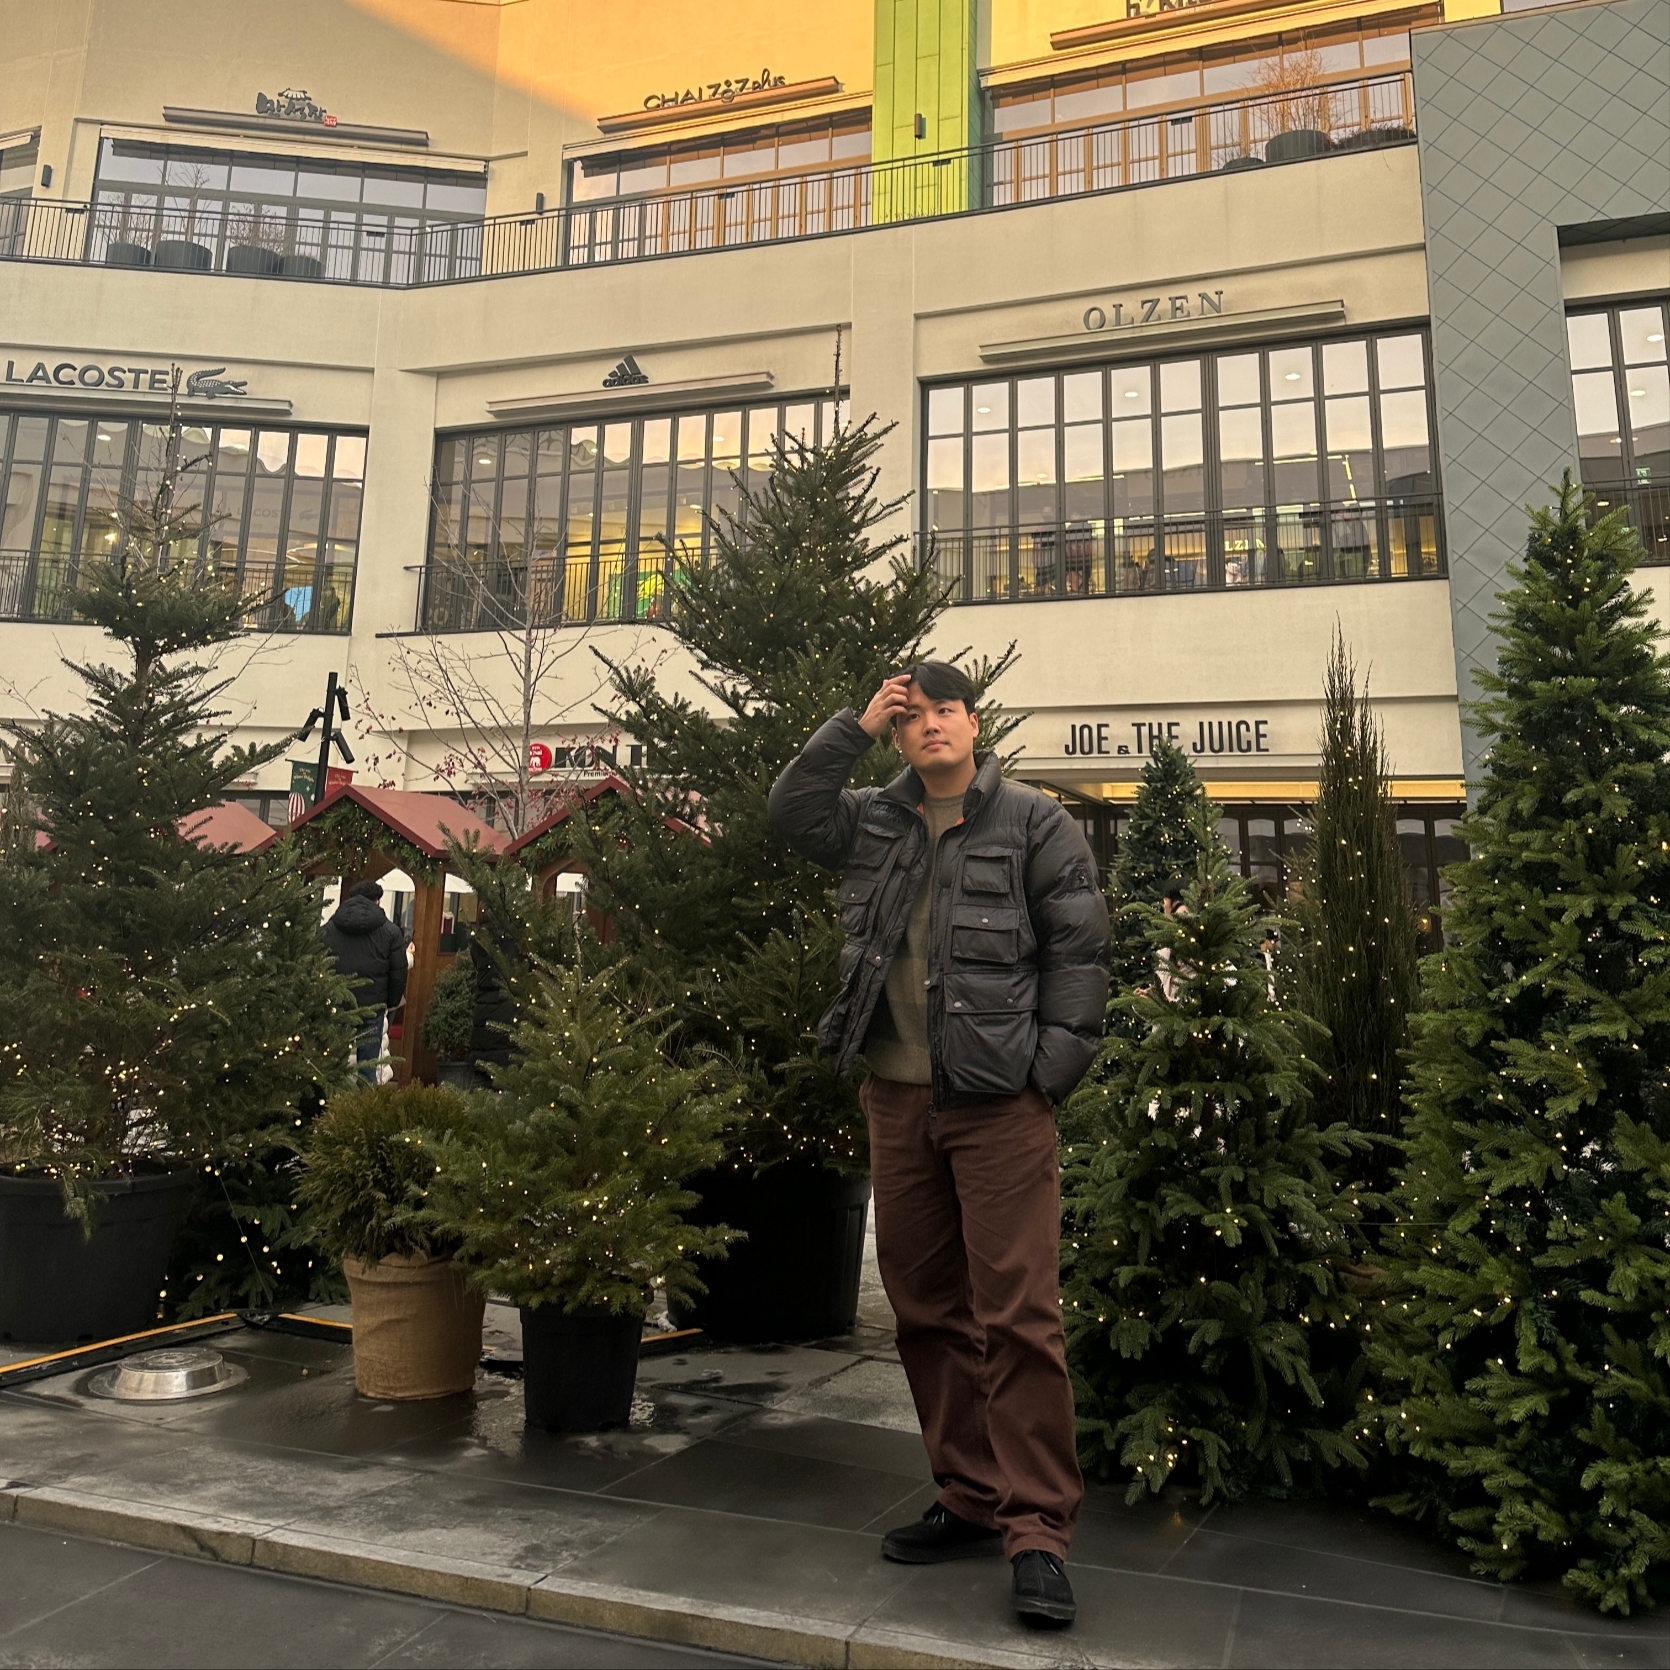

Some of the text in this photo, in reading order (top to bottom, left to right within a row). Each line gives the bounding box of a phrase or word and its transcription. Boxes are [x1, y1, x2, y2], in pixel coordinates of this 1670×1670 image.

[1083, 290, 1224, 331] OLZEN
[5, 360, 170, 392] LACOSTE
[602, 374, 649, 388] adidas
[1064, 720, 1270, 756] JOE & THE JUICE
